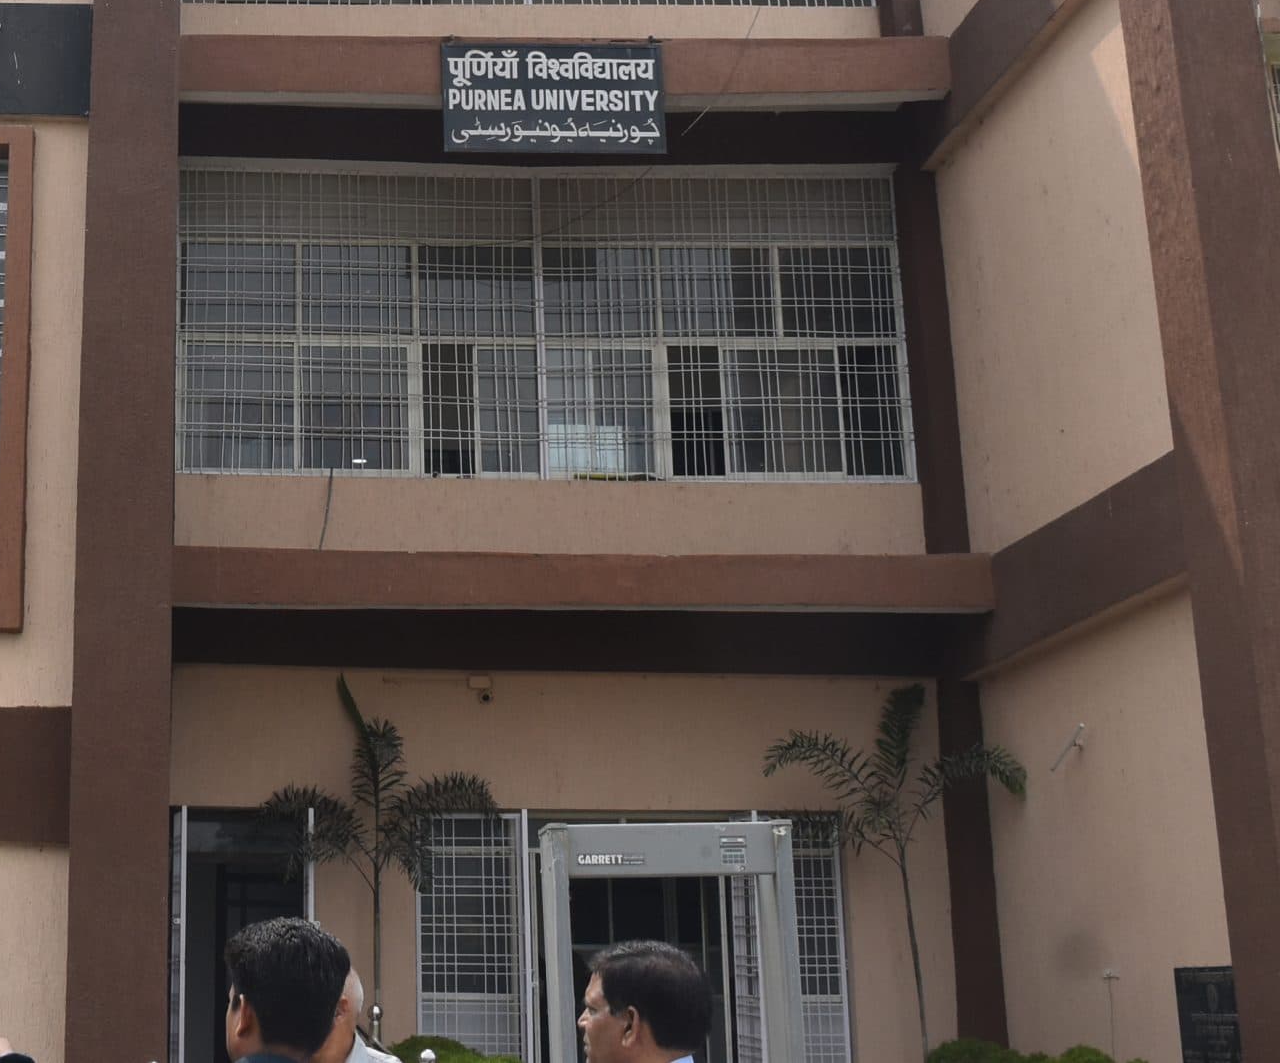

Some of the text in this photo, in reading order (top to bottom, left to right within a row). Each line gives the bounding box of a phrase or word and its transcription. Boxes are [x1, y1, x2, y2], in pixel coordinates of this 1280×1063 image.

[447, 49, 655, 87] पूर्णियाँ विश्वविद्यालय
[448, 88, 658, 112] PURNEA UNIVERSITY
[578, 854, 623, 865] GARRETT
